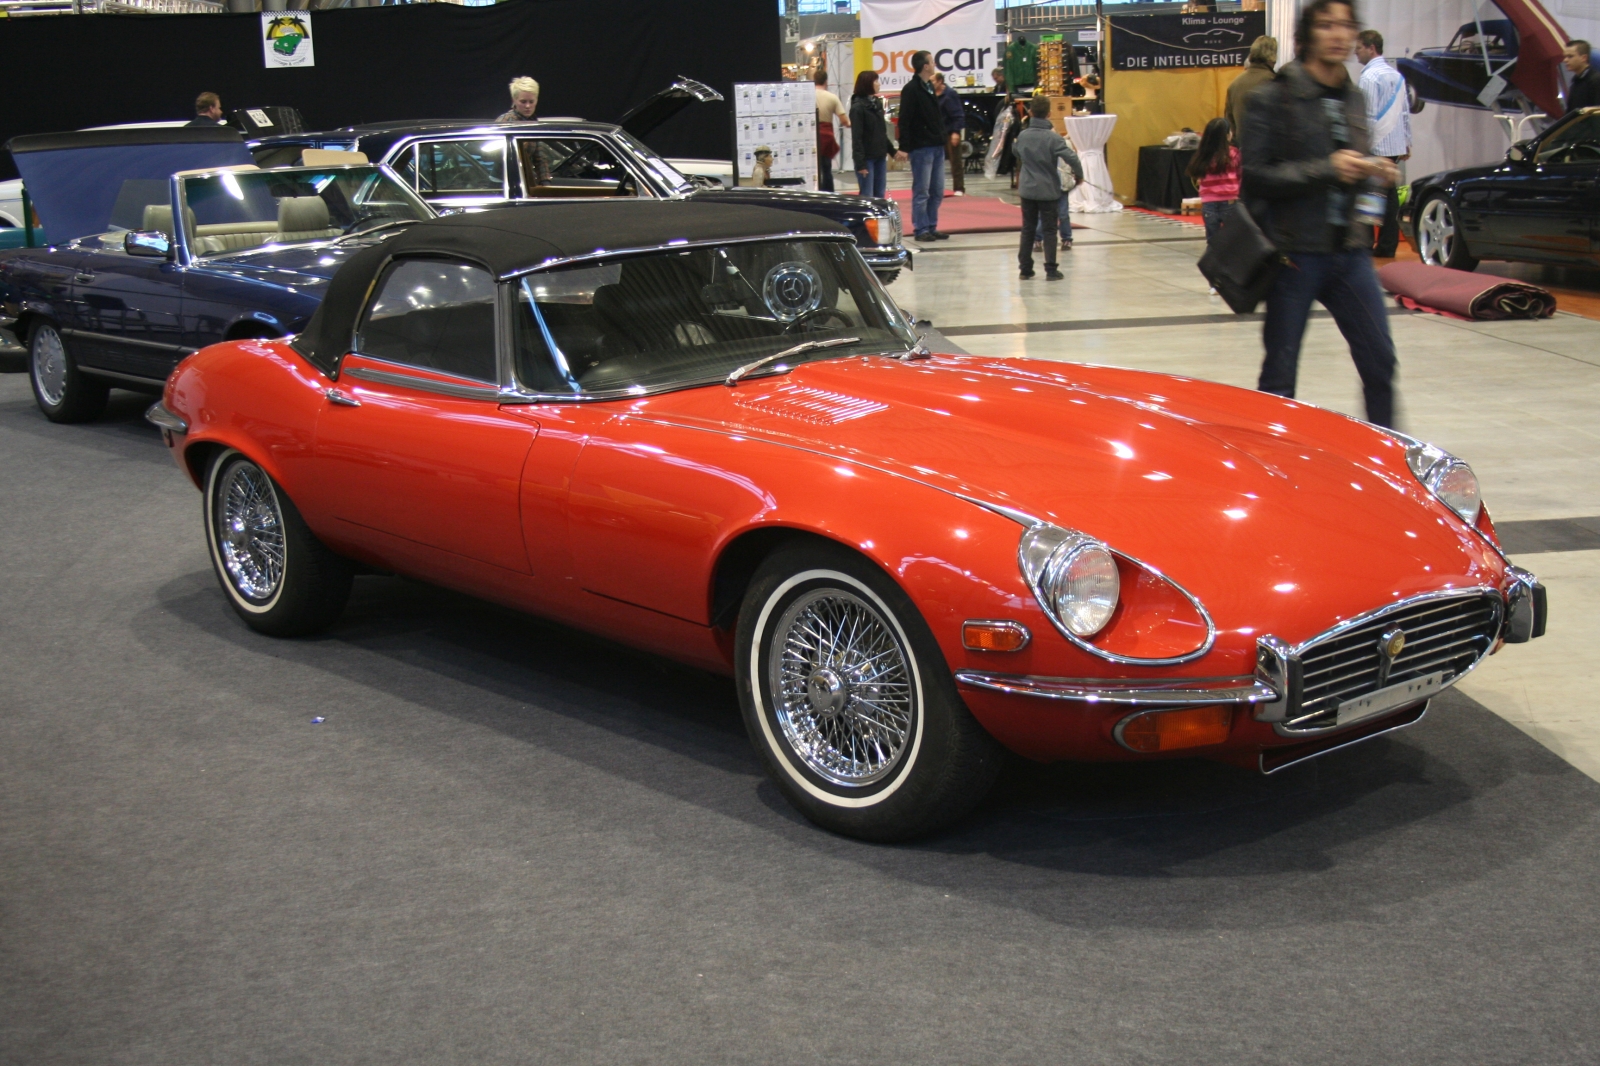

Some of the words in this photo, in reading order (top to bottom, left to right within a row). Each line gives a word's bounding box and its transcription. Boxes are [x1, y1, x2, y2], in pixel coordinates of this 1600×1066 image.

[1182, 17, 1206, 26] Klima
[1212, 16, 1245, 26] Lounge
[934, 47, 991, 72] car
[1126, 57, 1148, 68] DIE
[1153, 53, 1242, 67] INTELLIGENTE
[880, 75, 913, 85] Weili
